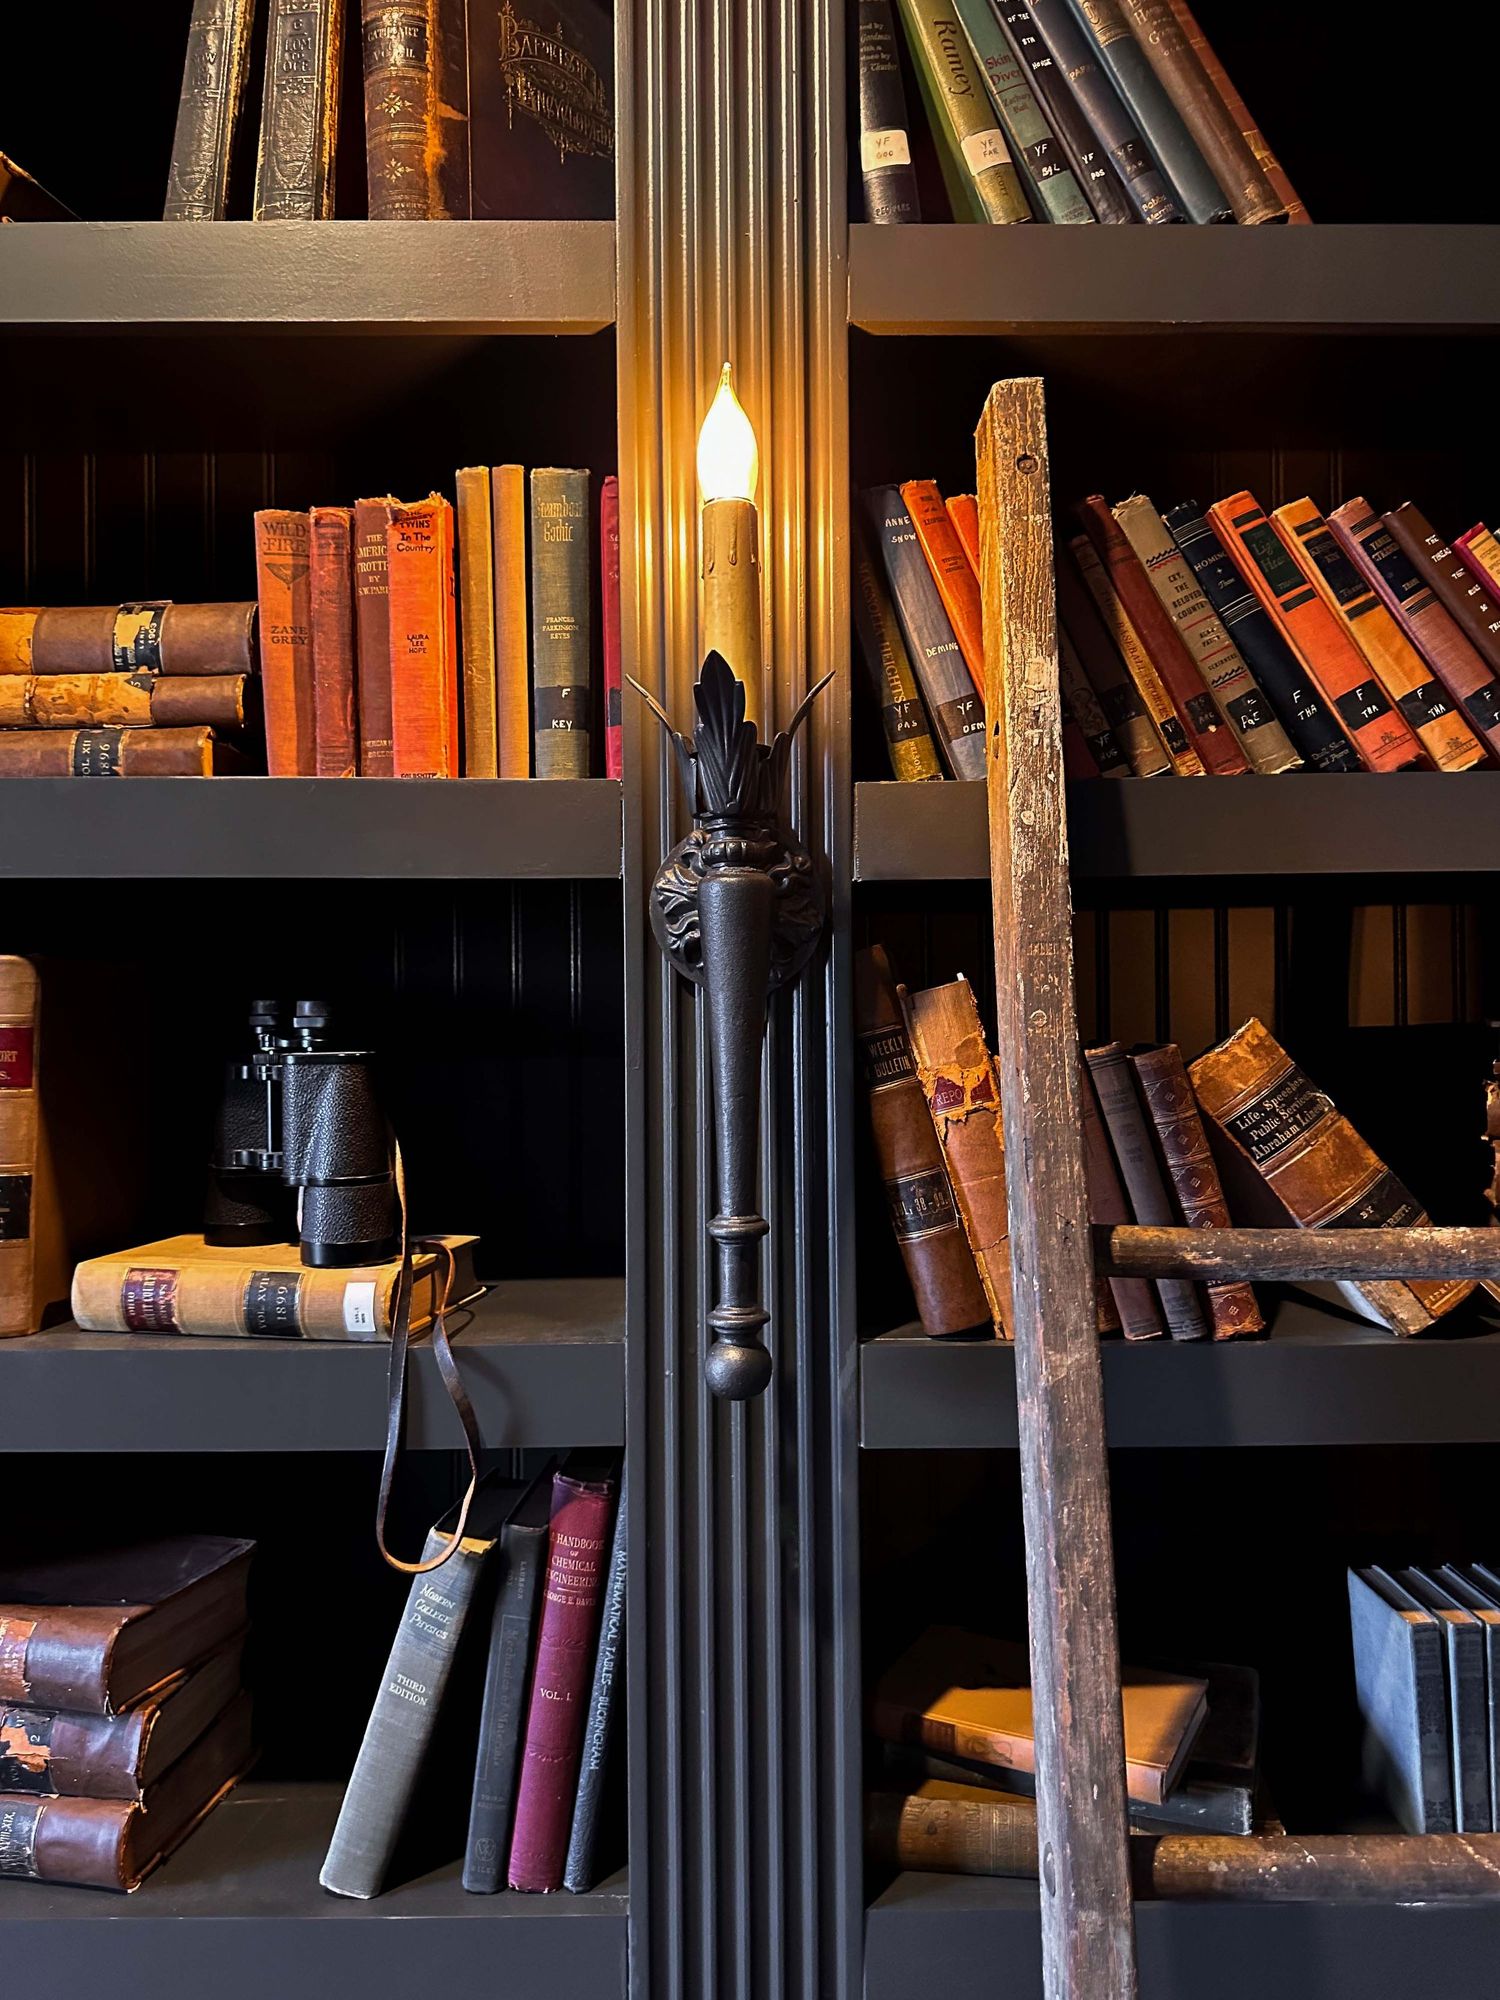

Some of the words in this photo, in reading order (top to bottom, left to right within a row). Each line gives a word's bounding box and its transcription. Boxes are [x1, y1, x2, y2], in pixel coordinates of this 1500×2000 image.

[932, 18, 975, 98] Ramey
[985, 52, 1010, 70] Skin
[1034, 143, 1048, 157] YF
[1081, 152, 1095, 165] YF
[884, 515, 911, 528] ANNE
[366, 534, 383, 543] THE
[400, 533, 411, 542] In
[413, 532, 431, 542] The
[890, 531, 917, 544] SNOW
[396, 543, 436, 554] Country
[1174, 582, 1190, 593] THE
[270, 625, 308, 635] ZANE
[270, 634, 309, 645] GREY
[406, 633, 430, 643] LAURA
[411, 640, 425, 648] LEE
[880, 640, 907, 705] HEIGHTS
[560, 687, 572, 700] F
[1291, 690, 1302, 704] F
[1355, 689, 1365, 701] F
[1416, 689, 1425, 700] F
[956, 700, 974, 716] YF
[1297, 703, 1318, 721] THA
[551, 718, 573, 732] KEY
[100, 743, 112, 775] 1896
[870, 1035, 905, 1057] WEEKLY
[874, 1054, 912, 1078] BULLETIN
[1235, 1110, 1265, 1131] Life,
[1248, 1116, 1281, 1142] Public
[1250, 1123, 1301, 1161] Abraham
[275, 1286, 288, 1322] 1899
[556, 1533, 604, 1551] HANDBOOK
[551, 1556, 597, 1573] CHEMICAL
[607, 1550, 629, 1640] MATHEMATICAL
[408, 1612, 449, 1640] PHYSICS
[396, 1673, 426, 1694] THIRD
[388, 1681, 428, 1707] EDITION
[540, 1687, 564, 1701] VOL.
